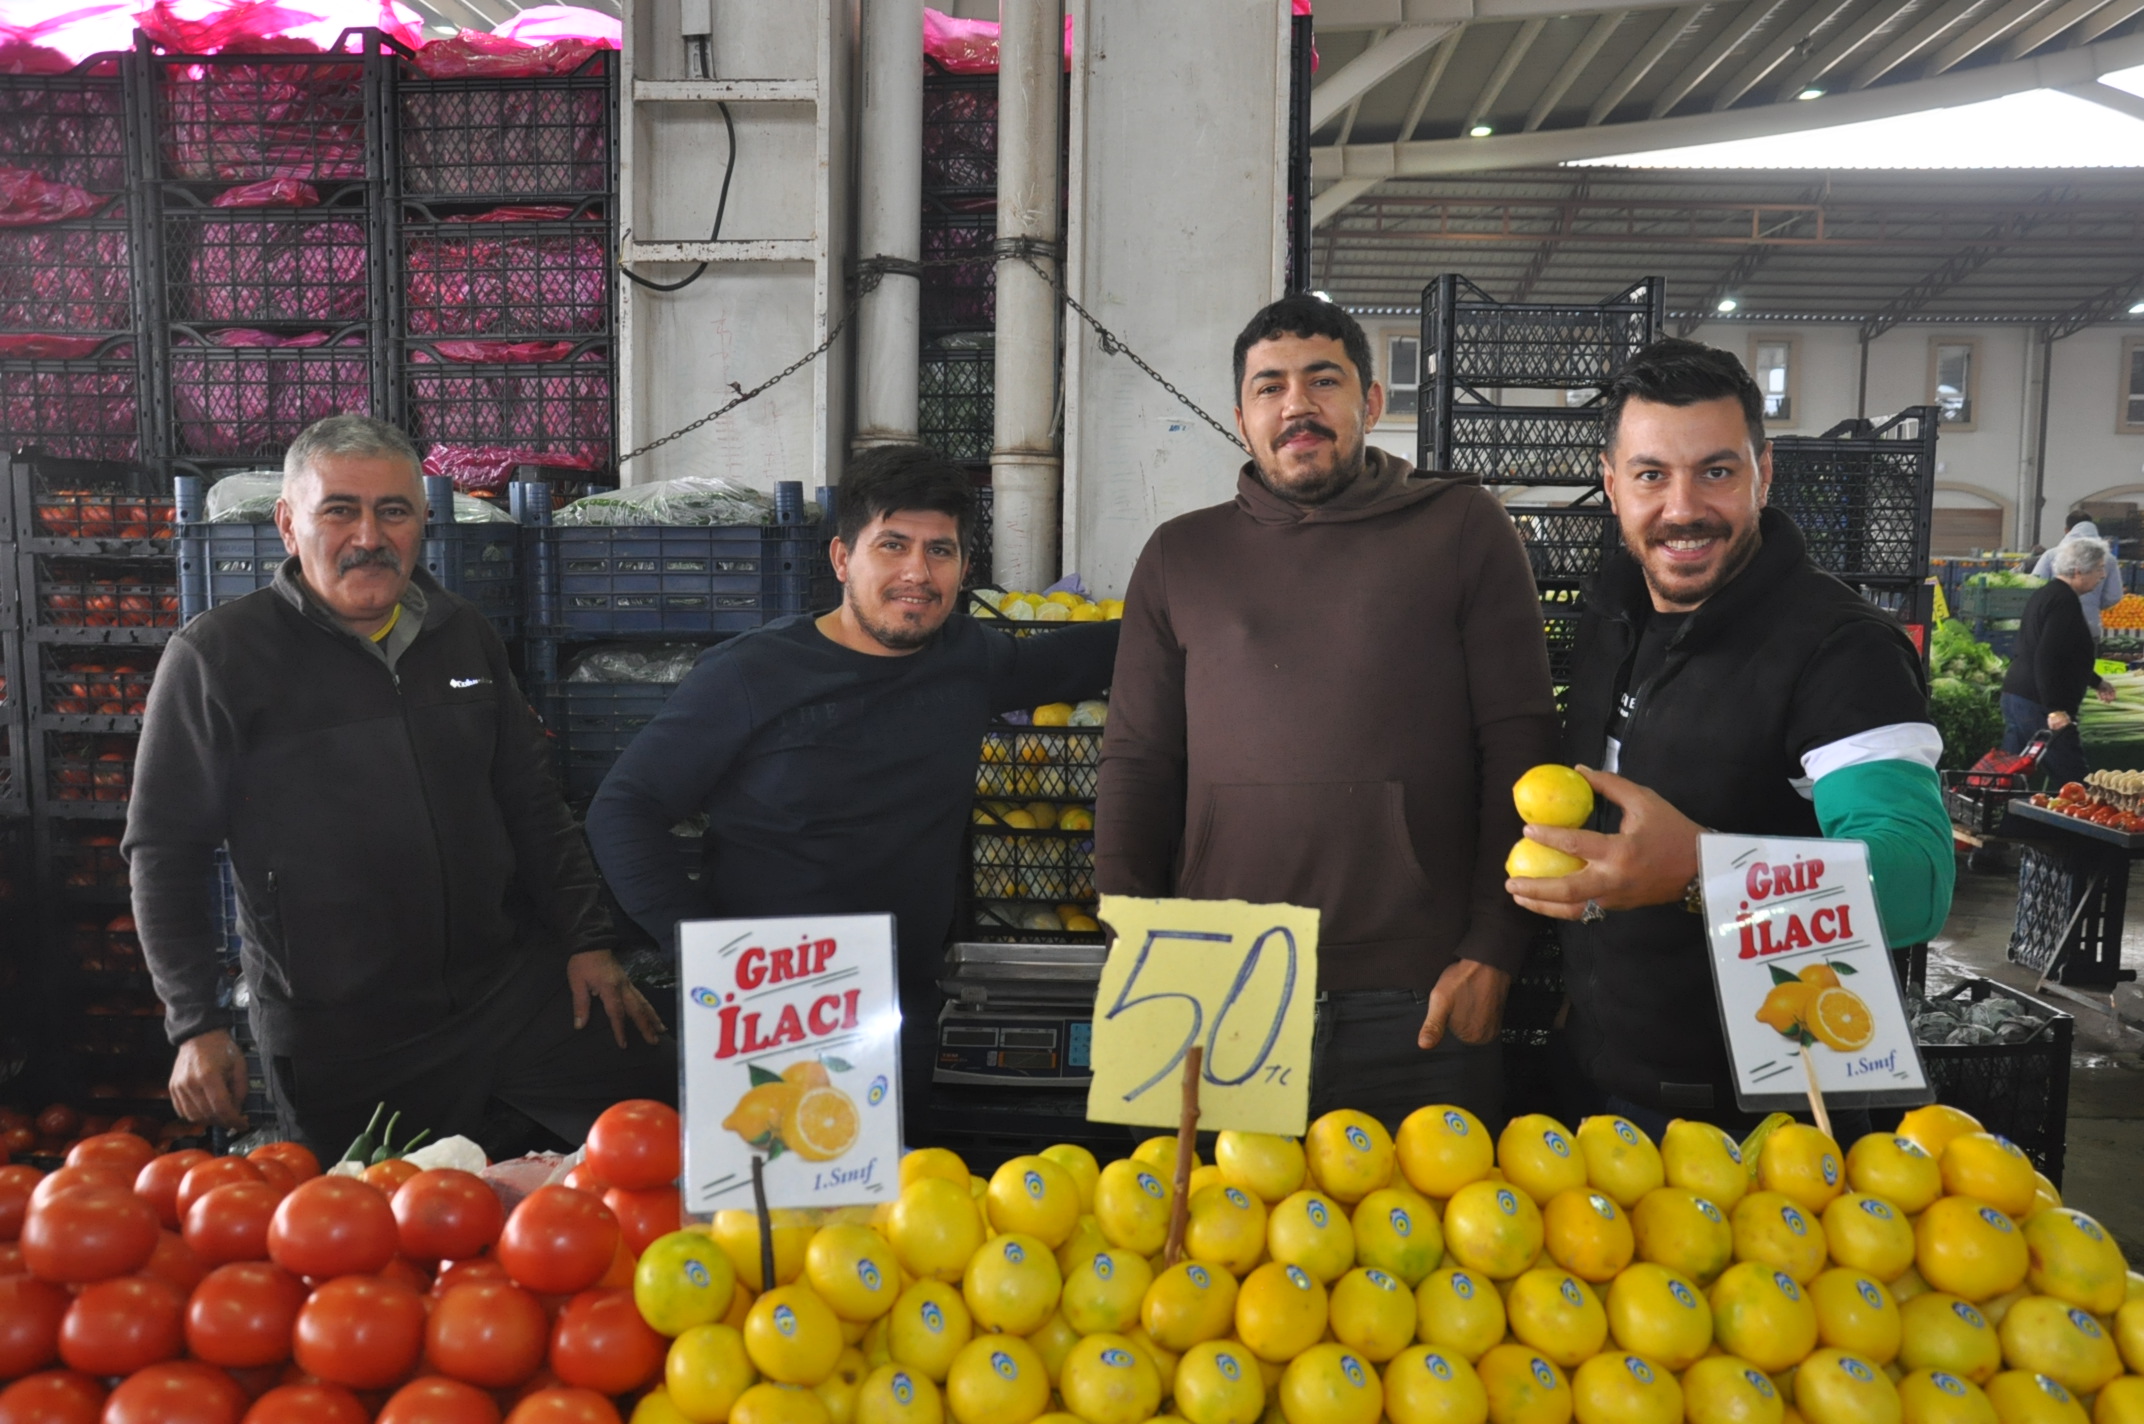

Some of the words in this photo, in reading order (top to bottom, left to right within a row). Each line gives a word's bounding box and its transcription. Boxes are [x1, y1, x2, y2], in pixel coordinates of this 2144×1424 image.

[1746, 854, 1825, 901] GRİP
[1736, 900, 1854, 960] İLACI
[735, 934, 837, 991] GRİP
[714, 989, 862, 1060] İLACI
[1104, 926, 1297, 1103] 50
